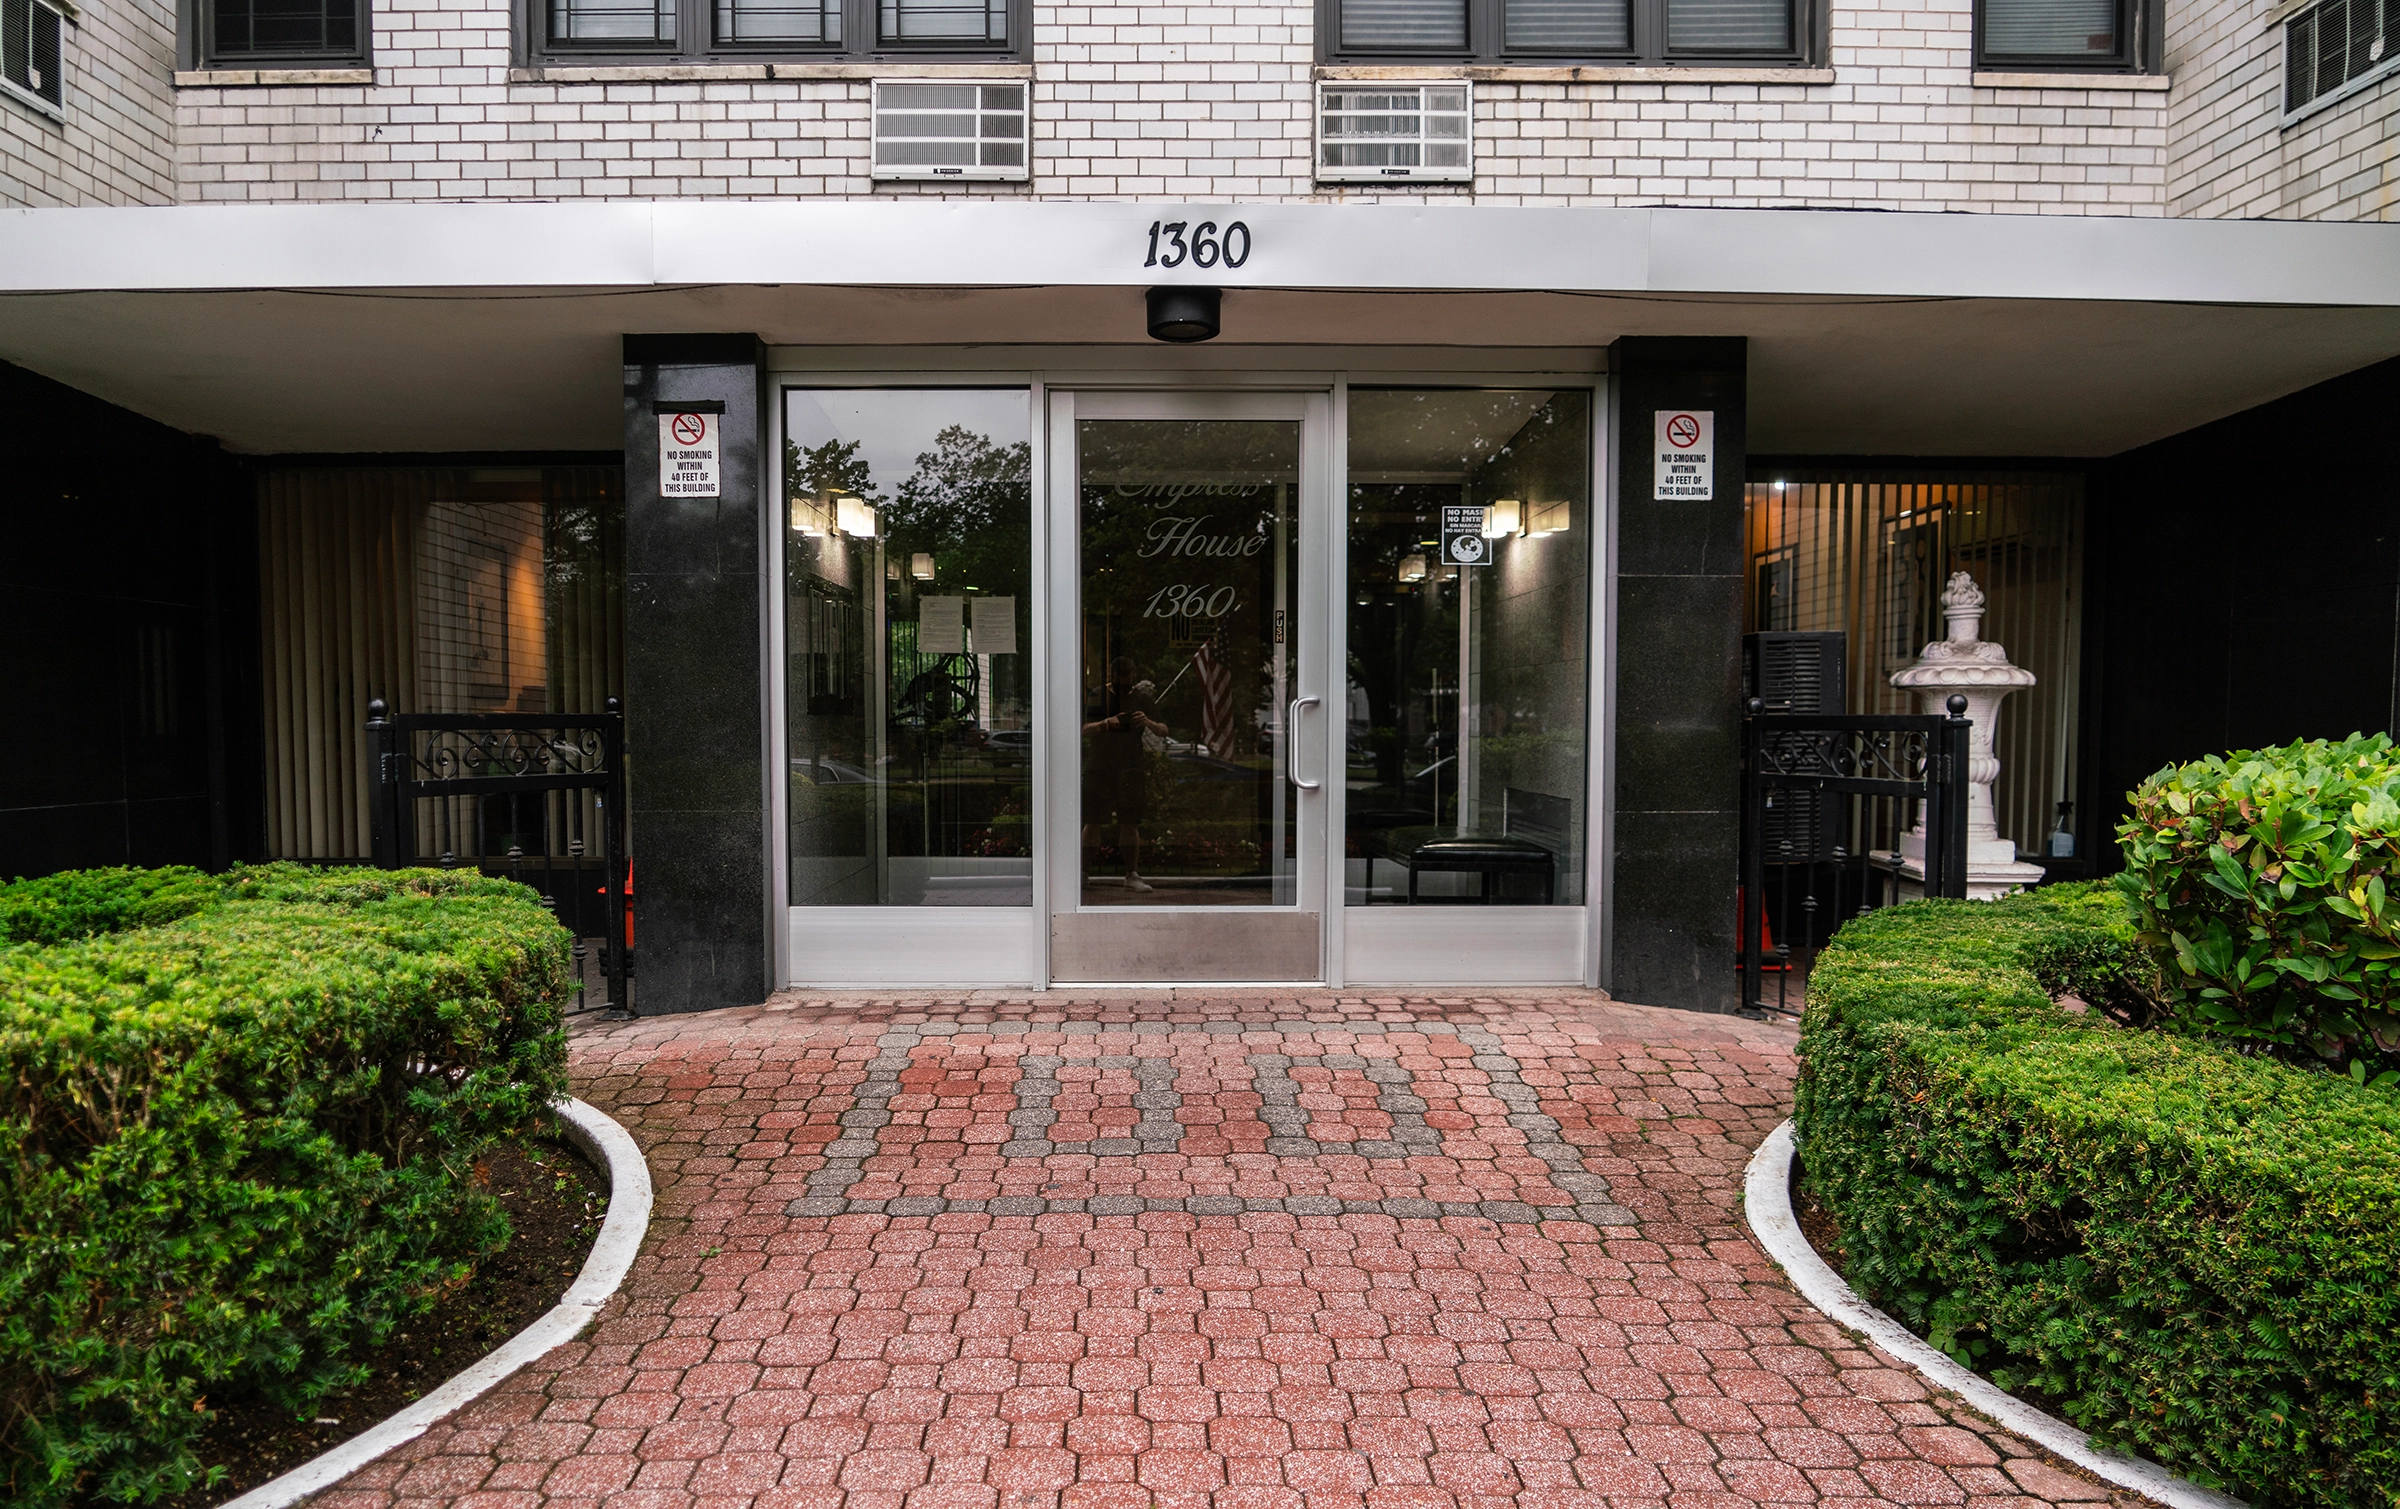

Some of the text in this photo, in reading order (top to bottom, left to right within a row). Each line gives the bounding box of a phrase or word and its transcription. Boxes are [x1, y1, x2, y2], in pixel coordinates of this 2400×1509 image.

[1144, 220, 1252, 269] 1360
[668, 450, 712, 460] NO SMOKING
[1662, 454, 1706, 463] NO SMOKING
[677, 462, 702, 470] WITHIN
[1671, 465, 1696, 474] WITHIN
[671, 472, 709, 482] 40 FEET OF
[1665, 476, 1702, 484] 40 FEET OF
[665, 484, 716, 492] THIS BUILDING
[1658, 486, 1708, 496] THIS BUILDING
[1136, 514, 1265, 558] House
[1142, 583, 1236, 618] 1360
